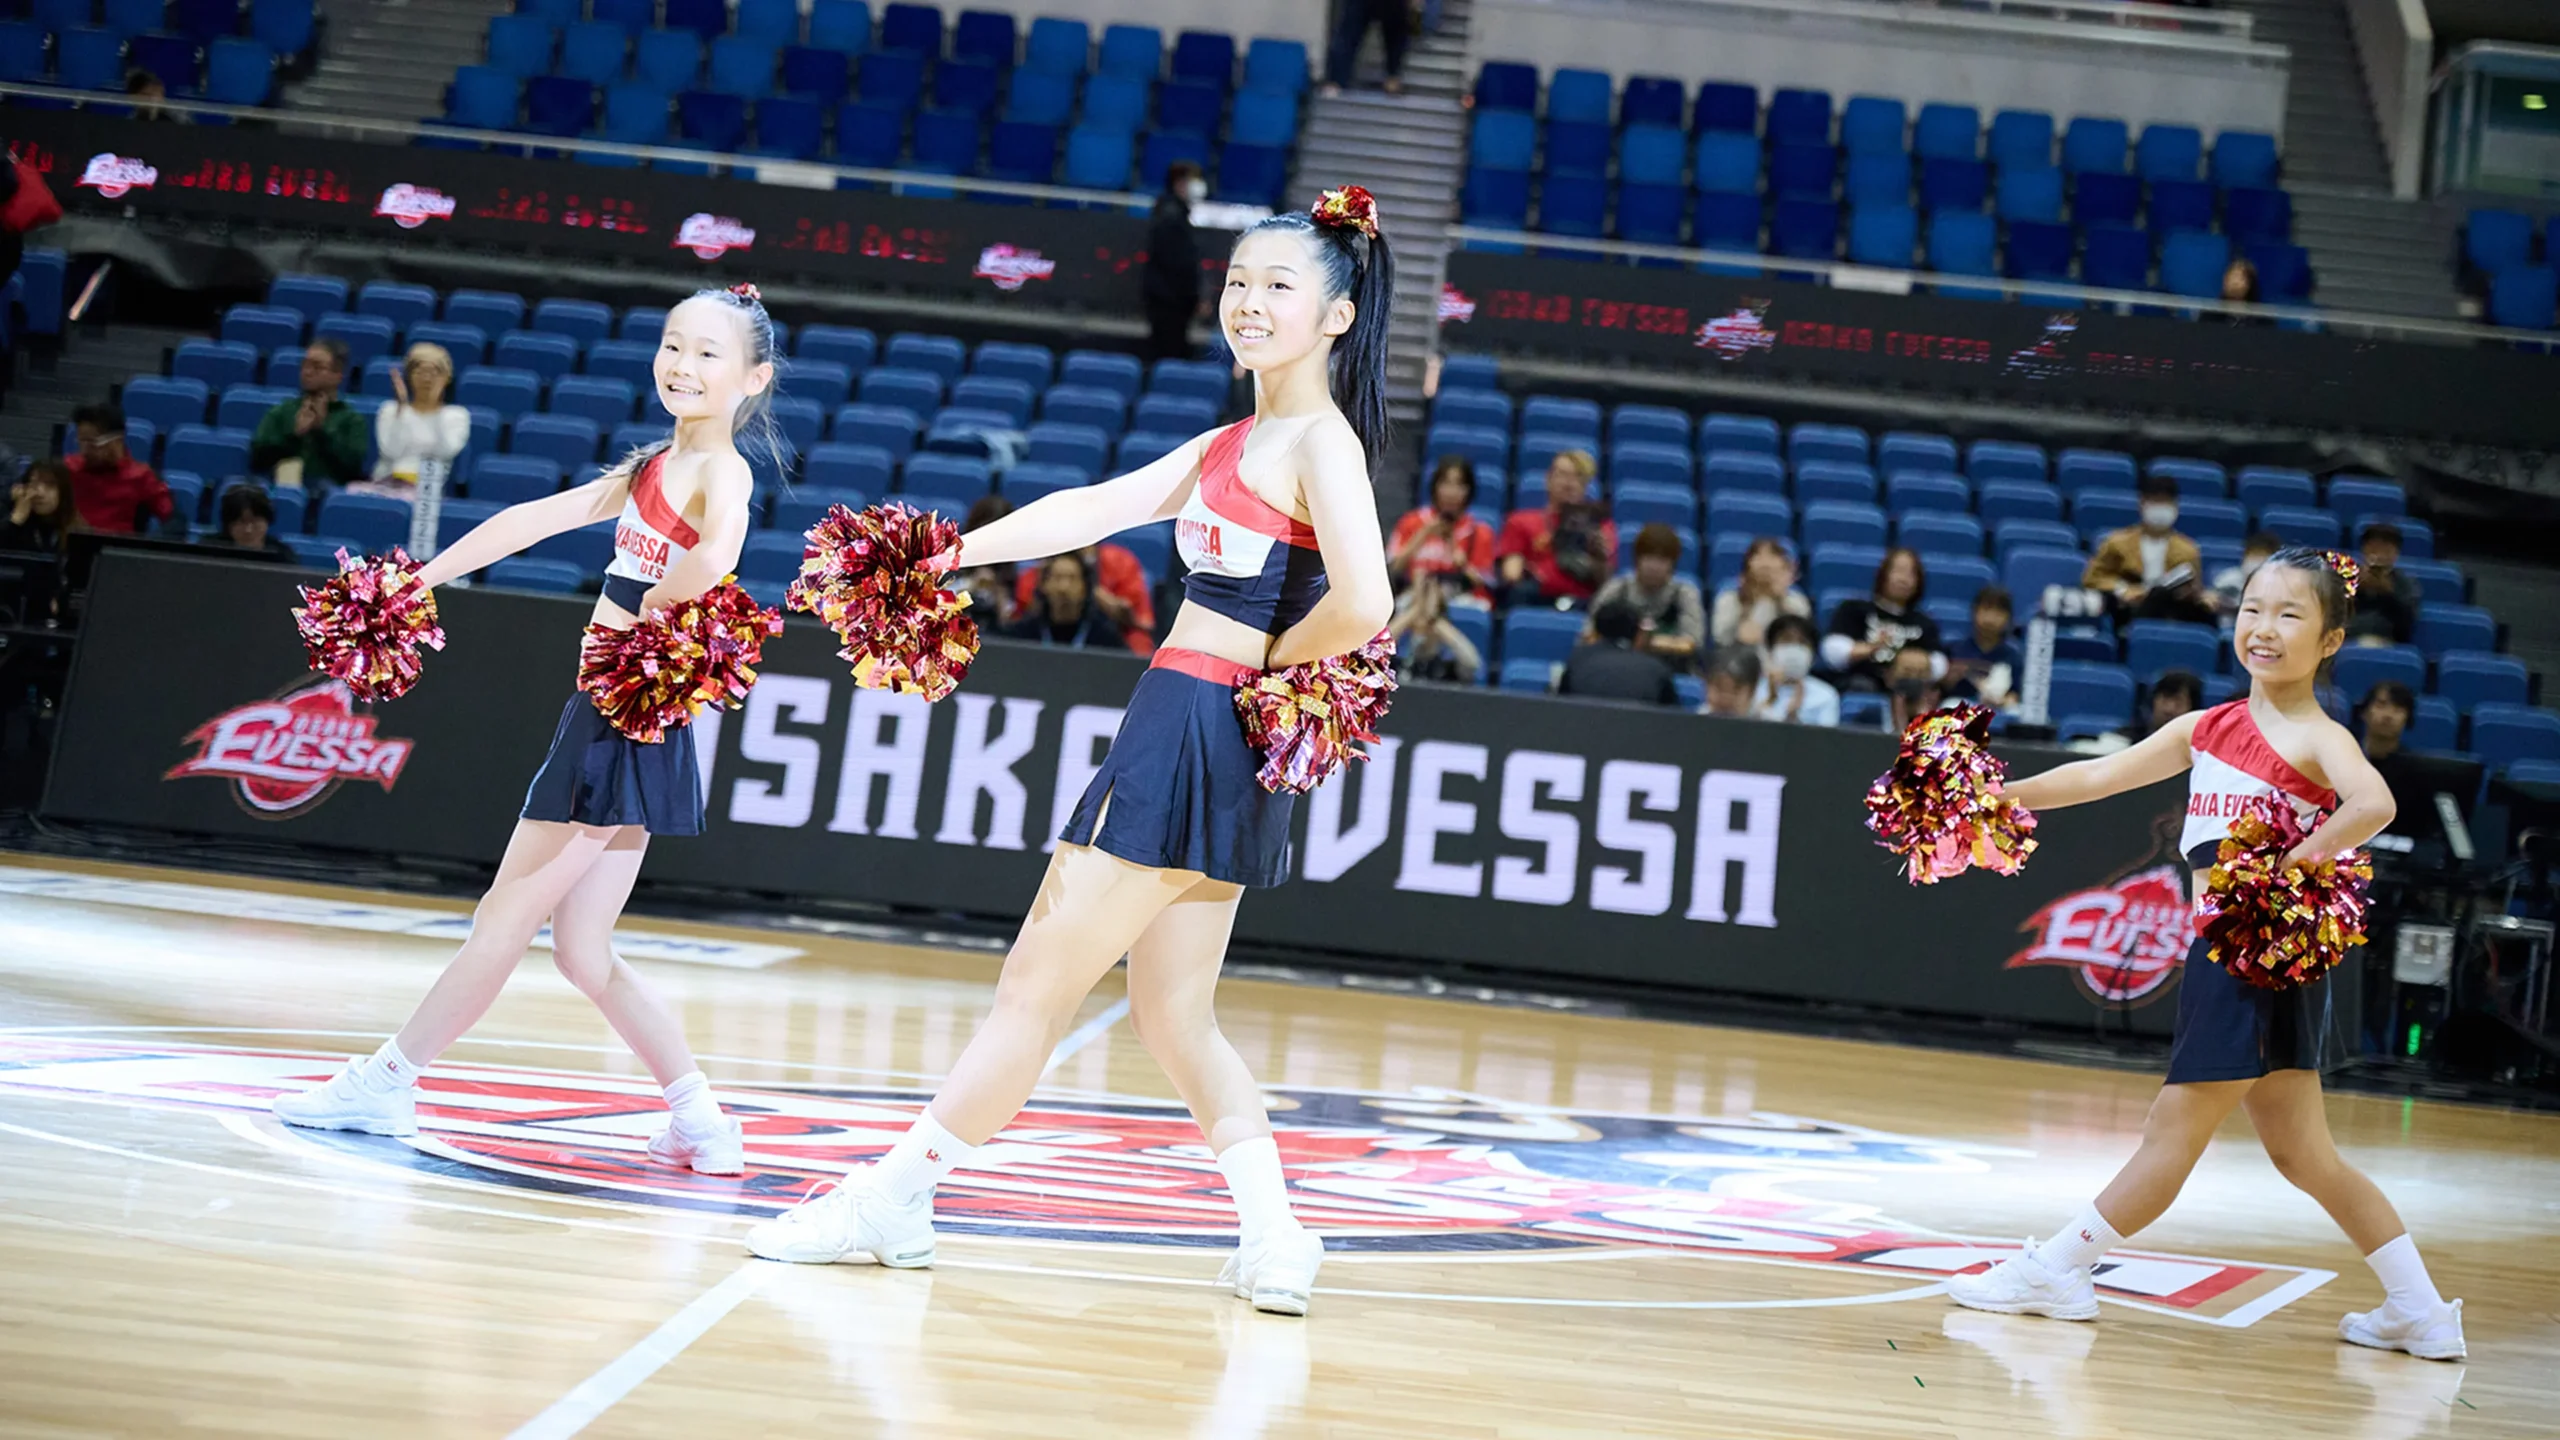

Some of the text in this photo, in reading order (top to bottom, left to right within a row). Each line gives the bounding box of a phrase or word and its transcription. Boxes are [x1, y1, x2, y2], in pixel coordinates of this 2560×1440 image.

[688, 672, 1127, 854] SAK
[1287, 739, 1787, 928] VESSA
[2027, 892, 2196, 972] EVES
